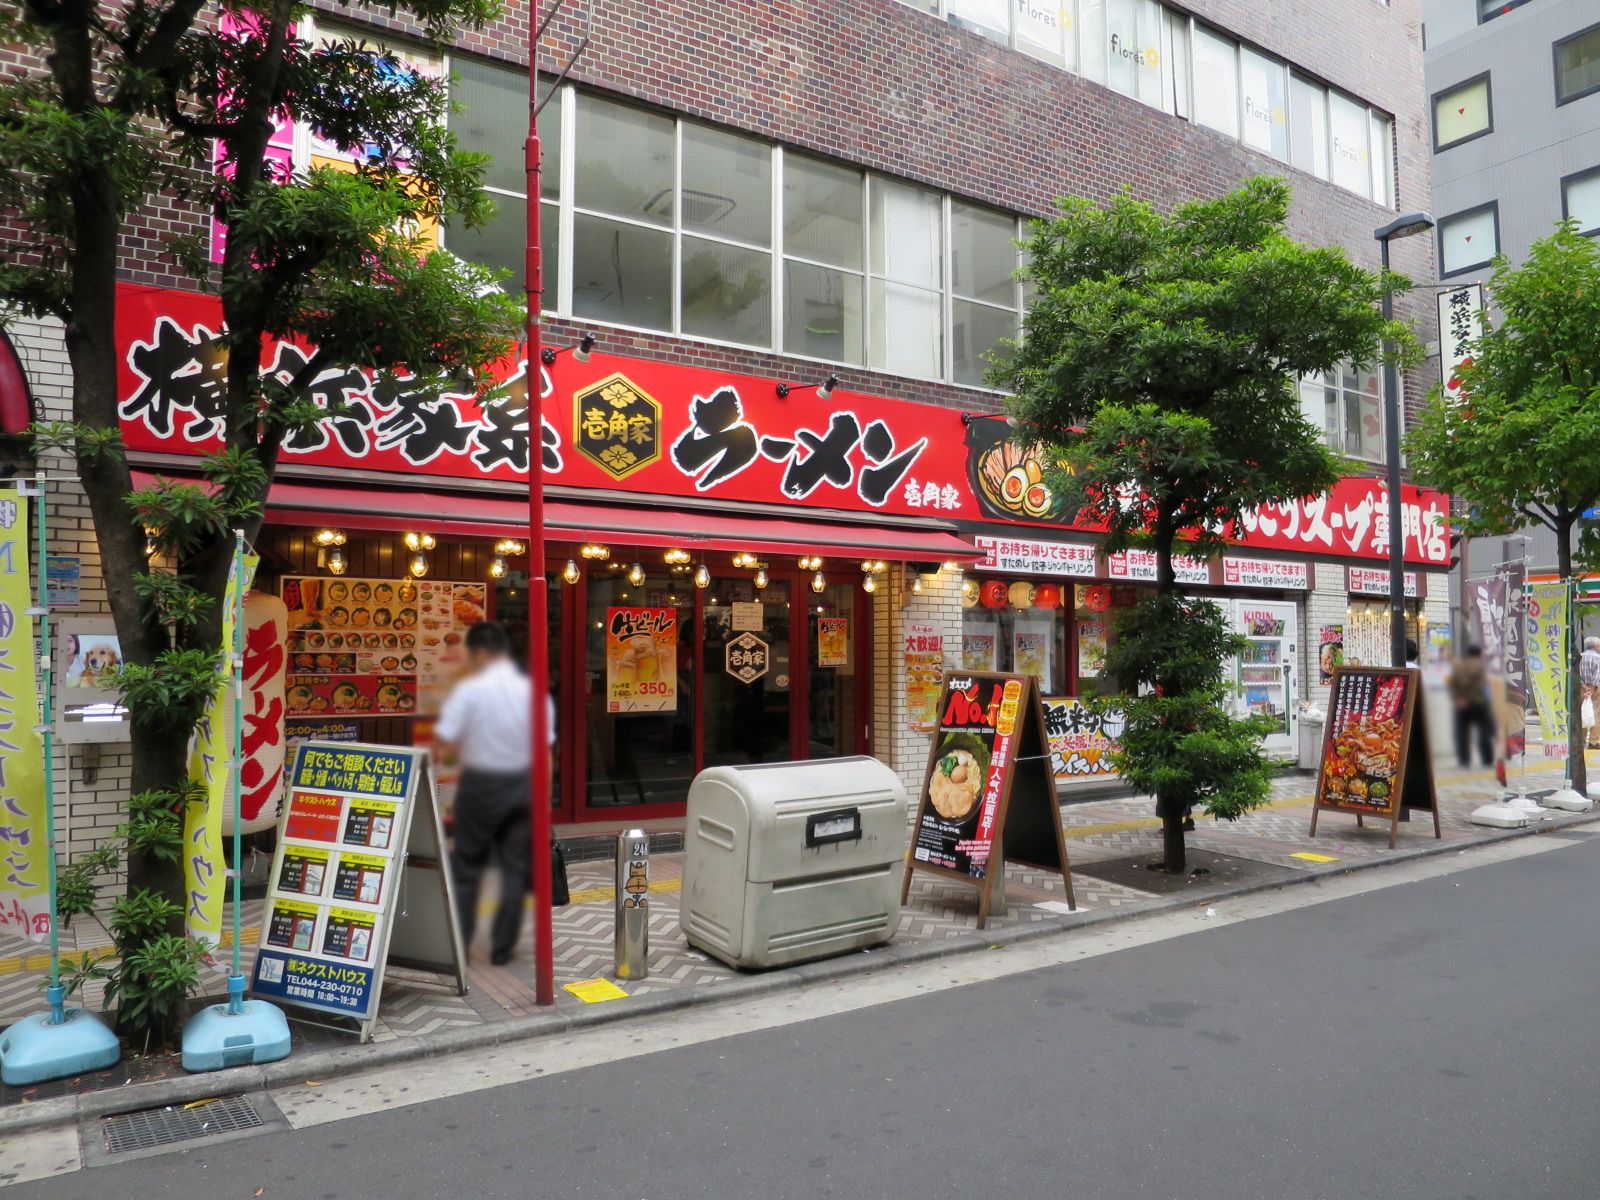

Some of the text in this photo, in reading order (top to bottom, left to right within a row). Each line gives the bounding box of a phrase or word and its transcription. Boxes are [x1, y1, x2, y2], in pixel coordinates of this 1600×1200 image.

[1110, 33, 1145, 66] flores
[1448, 290, 1472, 358] 横浜家系
[582, 406, 654, 445] 壱角家
[670, 385, 929, 508] ラーメン
[1113, 566, 1127, 575] OUT
[730, 651, 765, 666] 壱角家
[941, 682, 1004, 727] No.1
